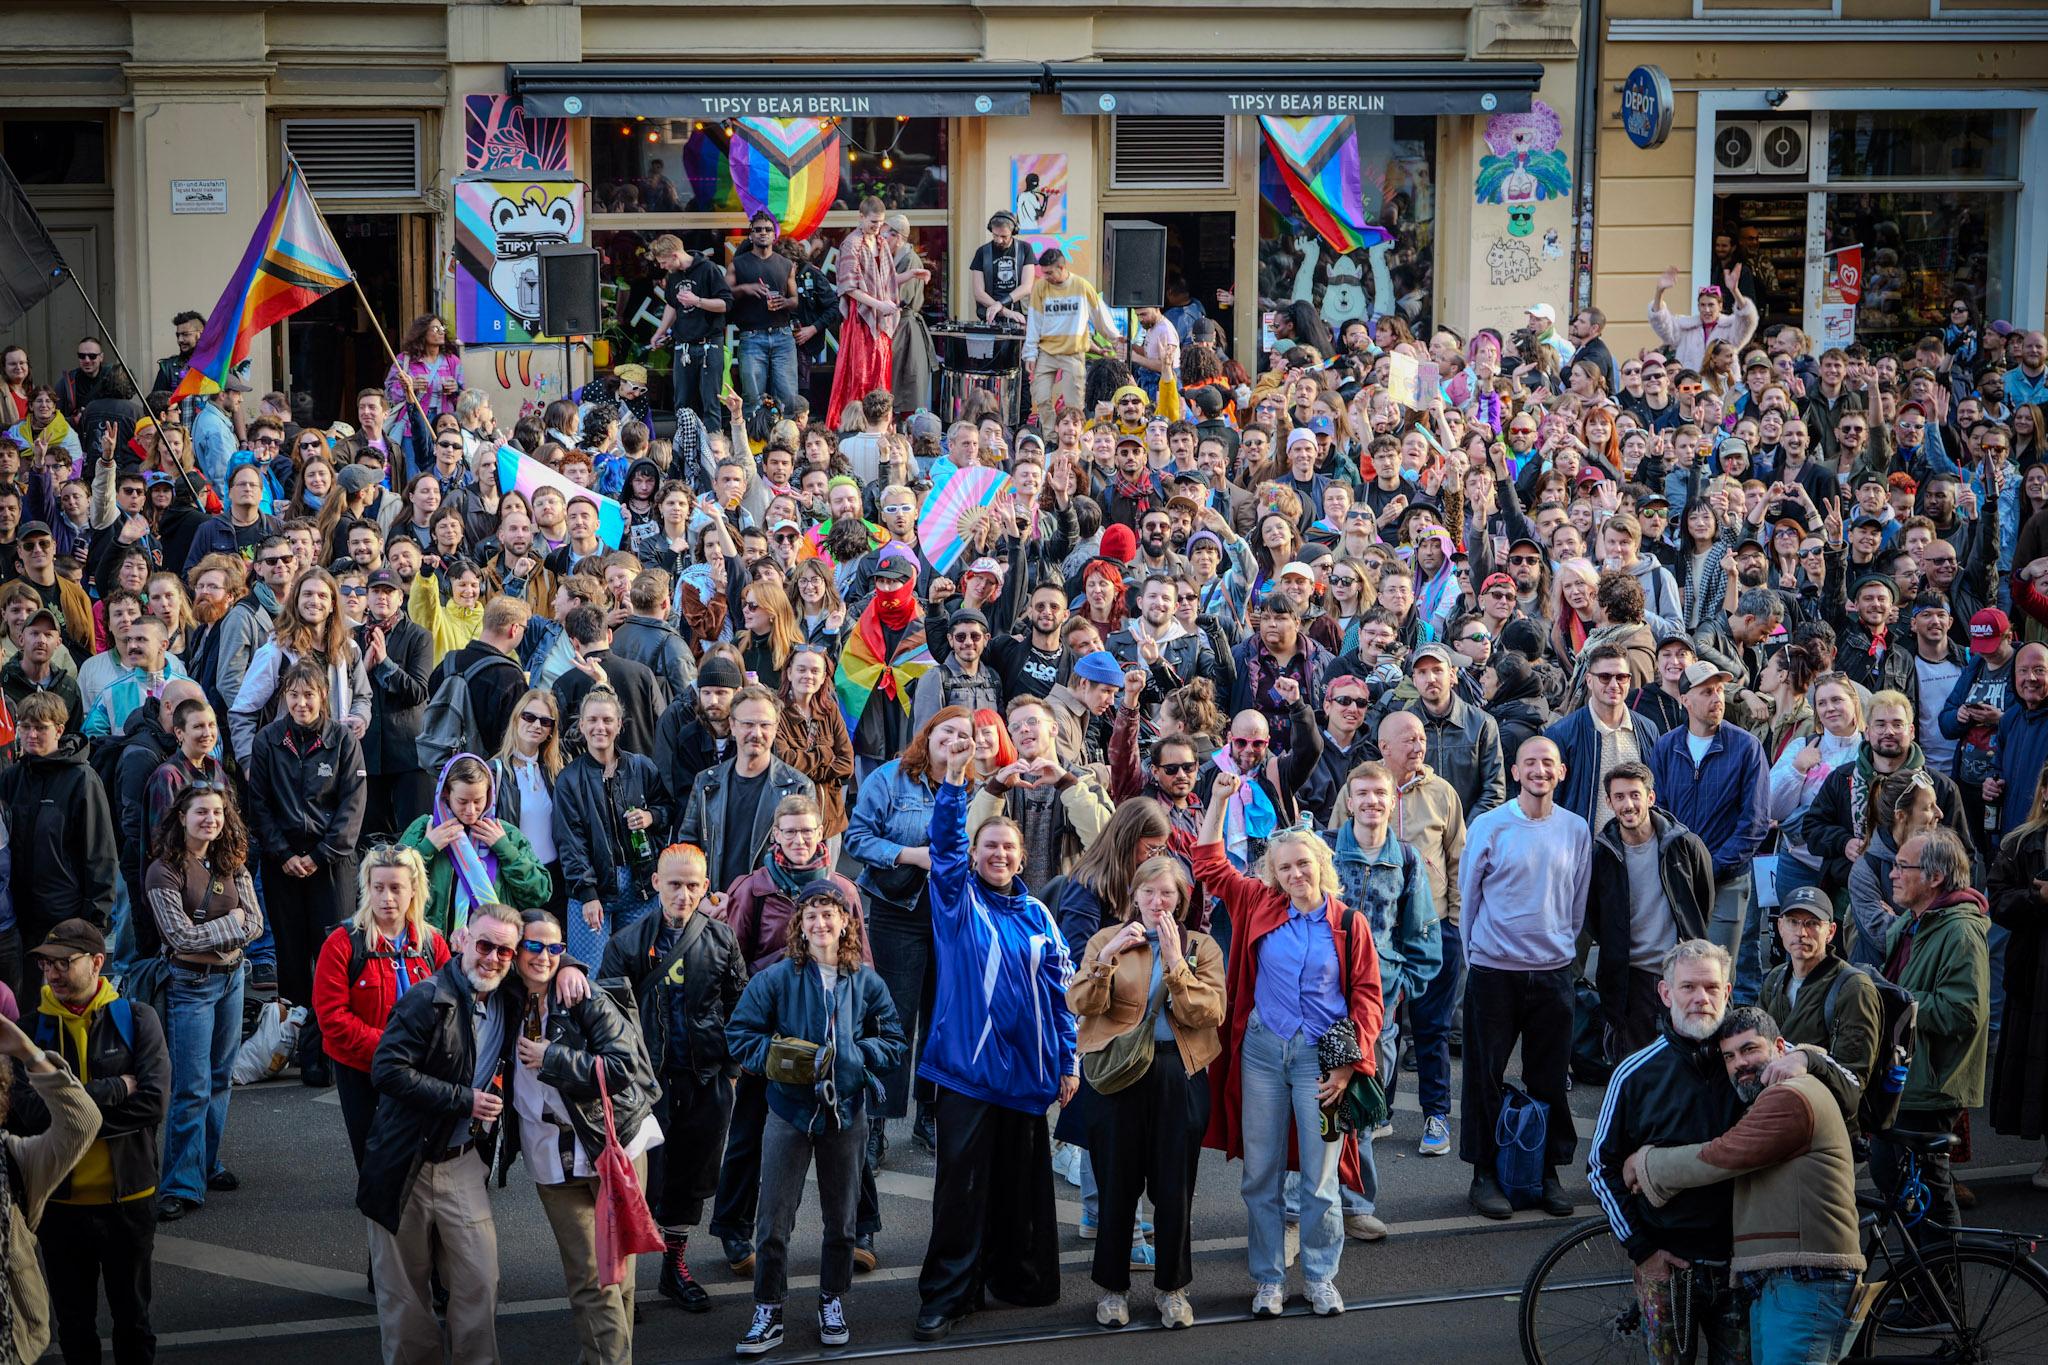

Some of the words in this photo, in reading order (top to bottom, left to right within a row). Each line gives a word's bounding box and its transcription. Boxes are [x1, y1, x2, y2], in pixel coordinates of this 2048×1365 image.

[701, 97, 751, 113] TIPSY
[808, 97, 870, 112] BERLIN
[1228, 94, 1275, 110] TIPSY
[1327, 95, 1385, 111] BERLIN
[1625, 90, 1655, 115] DEPOT
[503, 241, 533, 252] TIPSY
[1504, 258, 1523, 268] LIKE
[1504, 268, 1529, 277] DANCE
[493, 320, 542, 331] BER
